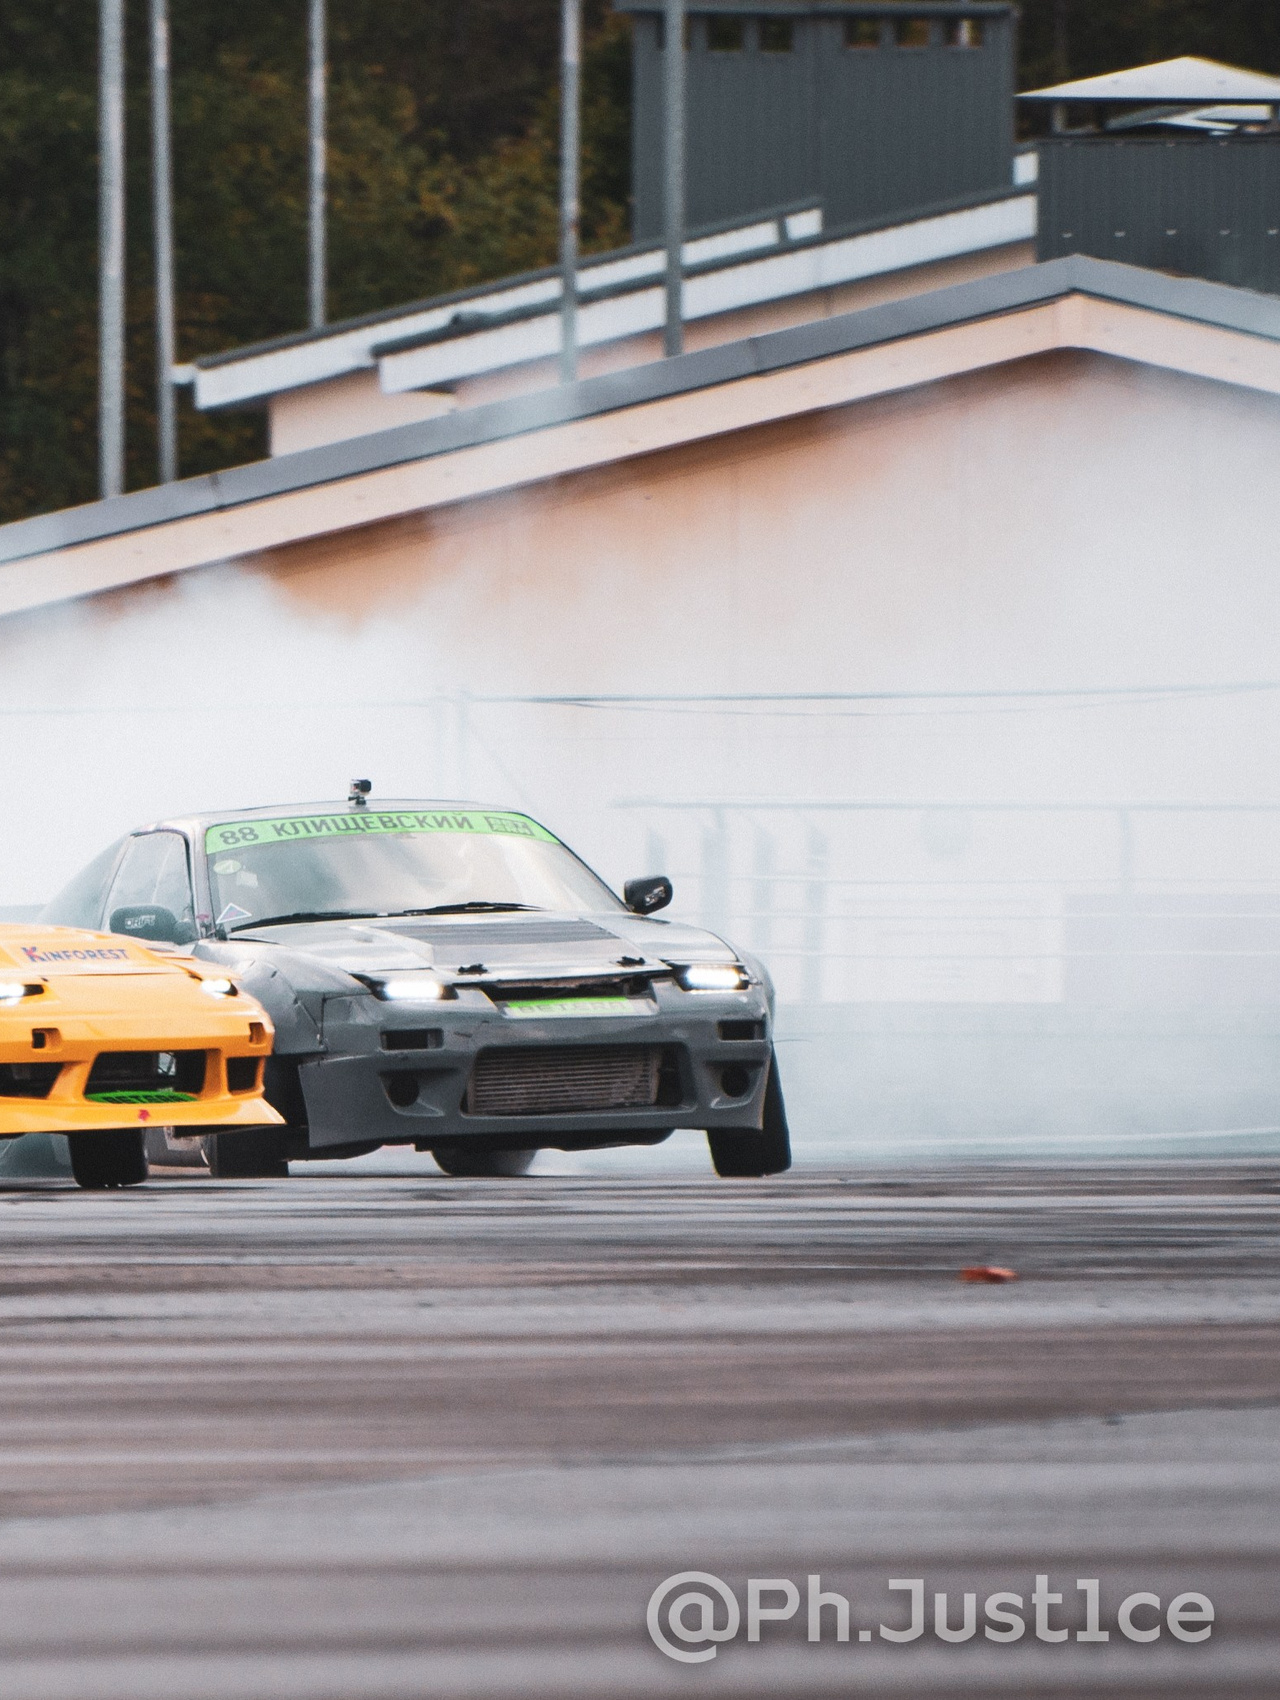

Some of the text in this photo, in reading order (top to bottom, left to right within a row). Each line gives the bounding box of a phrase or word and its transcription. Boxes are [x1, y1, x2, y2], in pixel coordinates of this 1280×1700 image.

[219, 826, 260, 845] 88
[272, 812, 474, 837] КЛИЩЕВСКИЙ
[22, 946, 129, 962] KINFOREST
